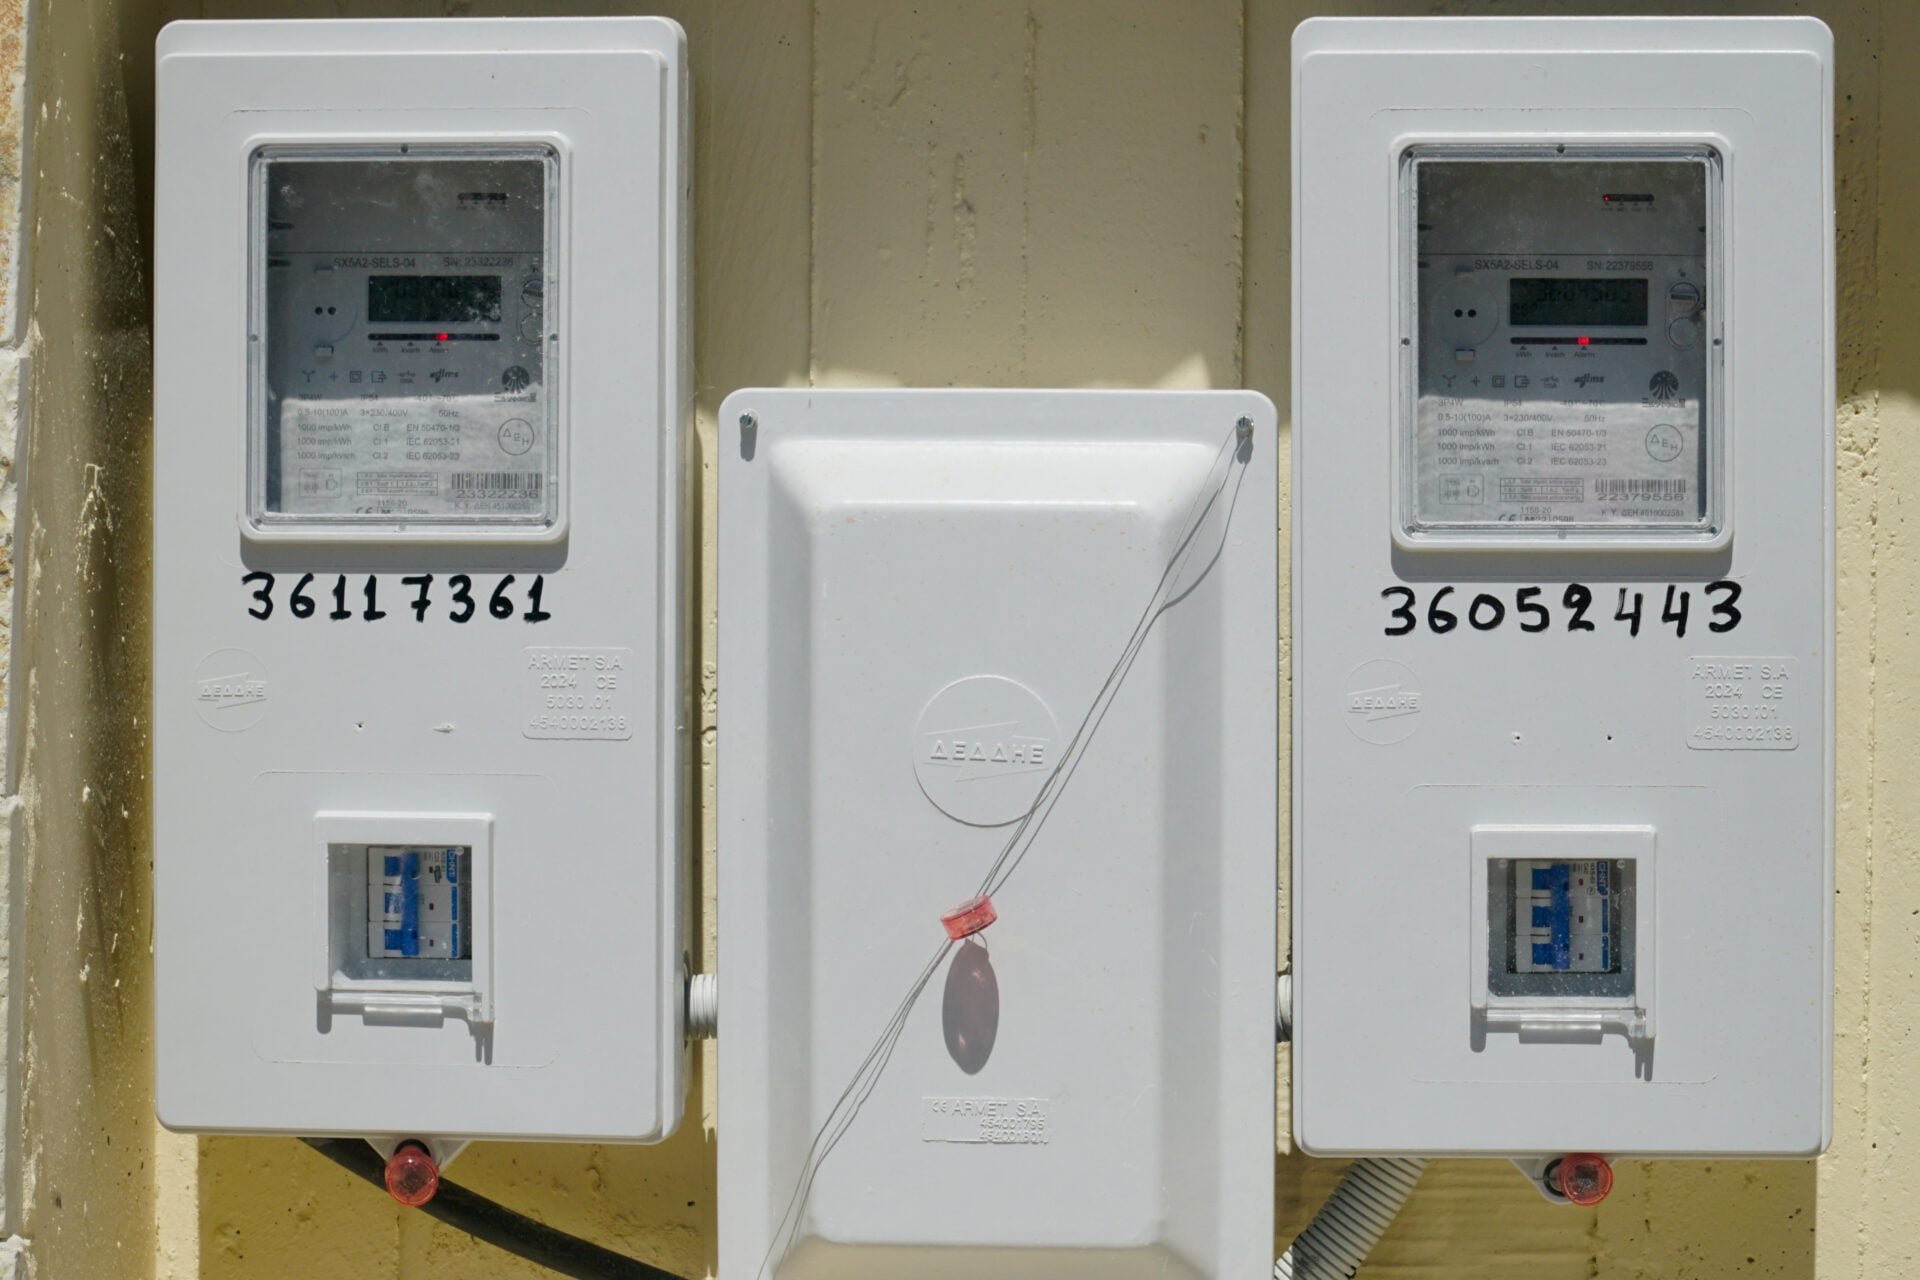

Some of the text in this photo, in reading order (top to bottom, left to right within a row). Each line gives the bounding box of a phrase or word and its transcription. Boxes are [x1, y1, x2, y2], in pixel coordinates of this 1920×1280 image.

[1474, 259, 1559, 271] SX5A2-SELS-04
[406, 424, 419, 432] EN
[1551, 429, 1564, 437] EN
[406, 438, 421, 446] IEC
[1551, 443, 1566, 451] IEC
[406, 452, 421, 460] IEC
[1551, 457, 1567, 465] IEC
[456, 488, 539, 499] 23322236
[1597, 493, 1685, 502] 22379556
[241, 571, 552, 623] 36117361
[1381, 580, 1743, 638] 36052443
[528, 654, 591, 671] ARMET
[1691, 664, 1753, 681] ARMET
[540, 673, 617, 690] 2024 CE
[1704, 683, 1784, 699] 2024 CE
[929, 738, 1045, 765] ΔΕΔΔΗΕ
[951, 1100, 1008, 1117] ARMET
